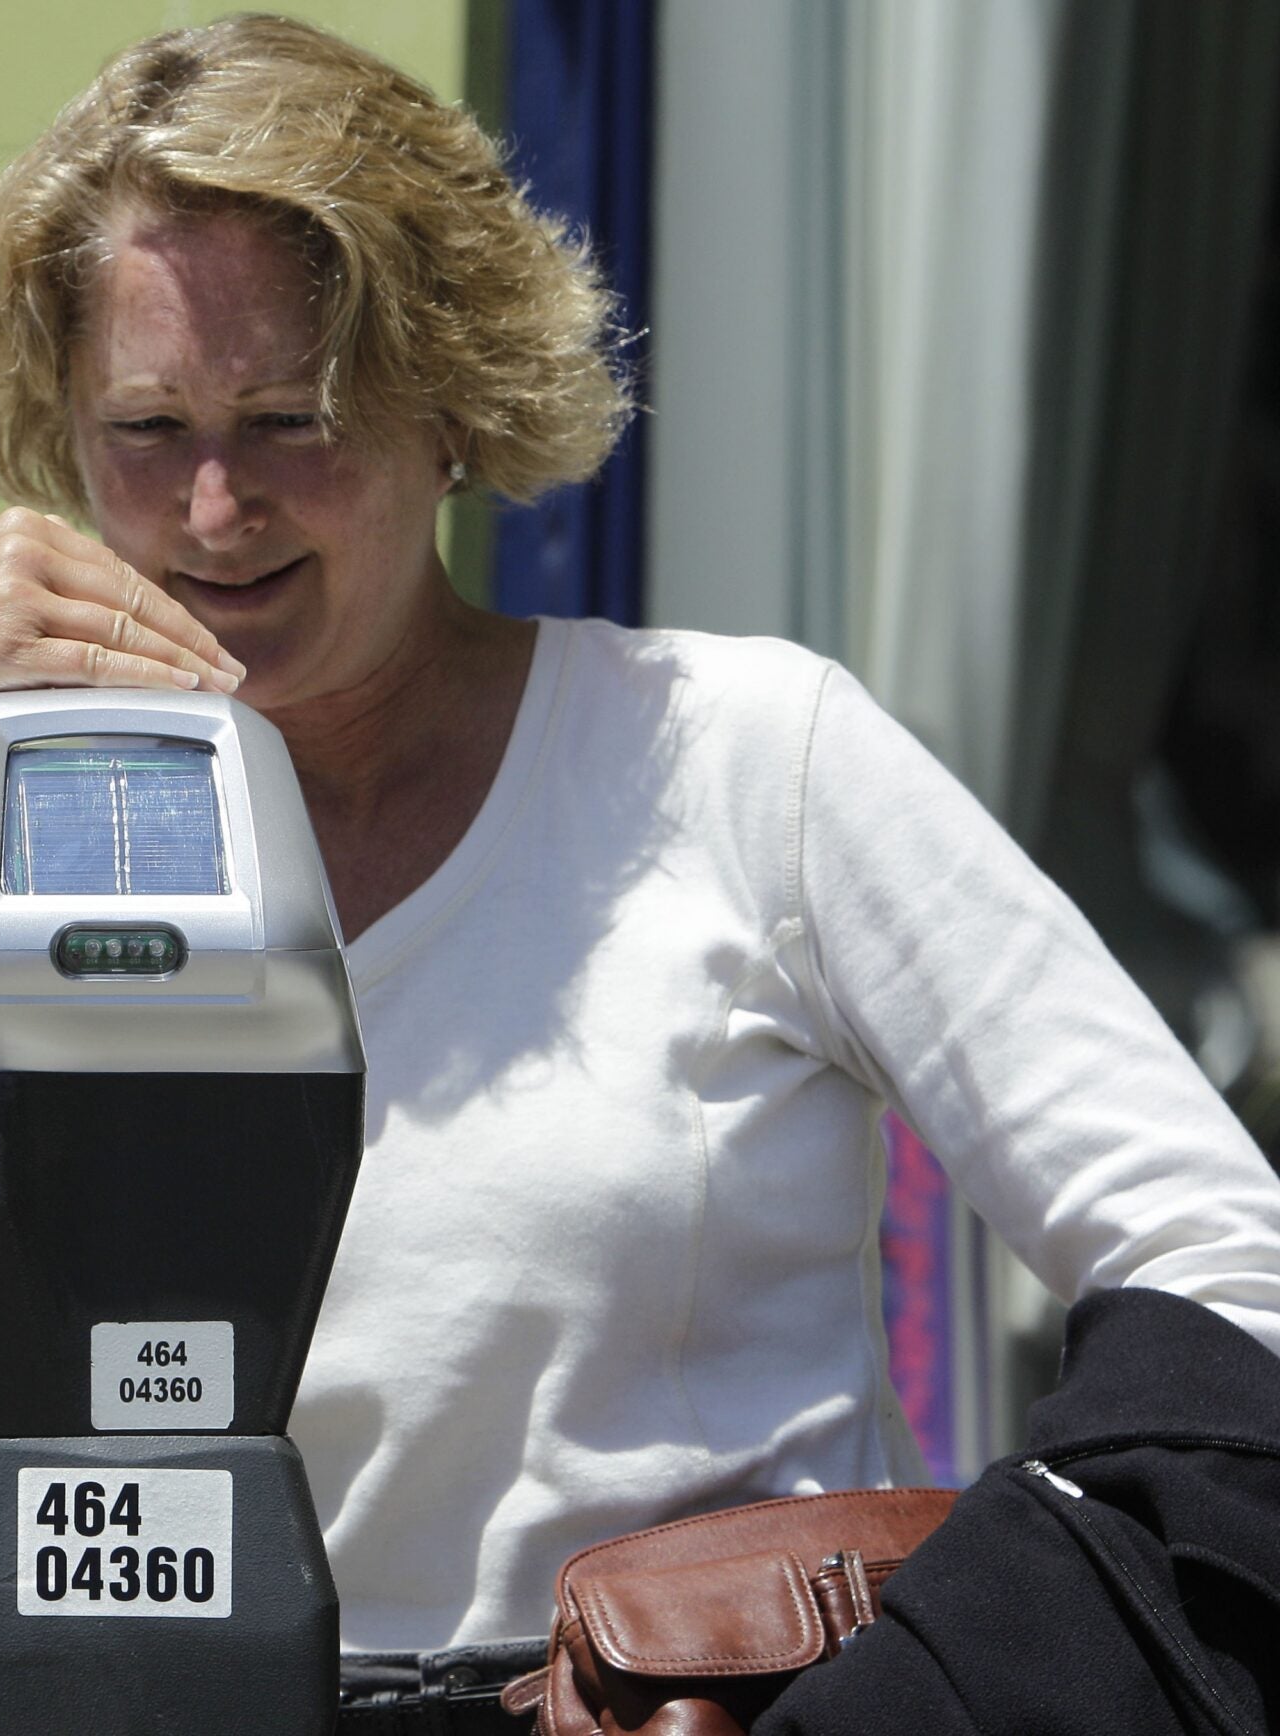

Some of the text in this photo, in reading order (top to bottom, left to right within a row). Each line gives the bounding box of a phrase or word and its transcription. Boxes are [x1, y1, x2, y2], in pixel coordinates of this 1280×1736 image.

[137, 1340, 188, 1367] 464
[119, 1377, 203, 1403] 04360
[36, 1481, 142, 1537] 464
[36, 1545, 215, 1603] 04360
